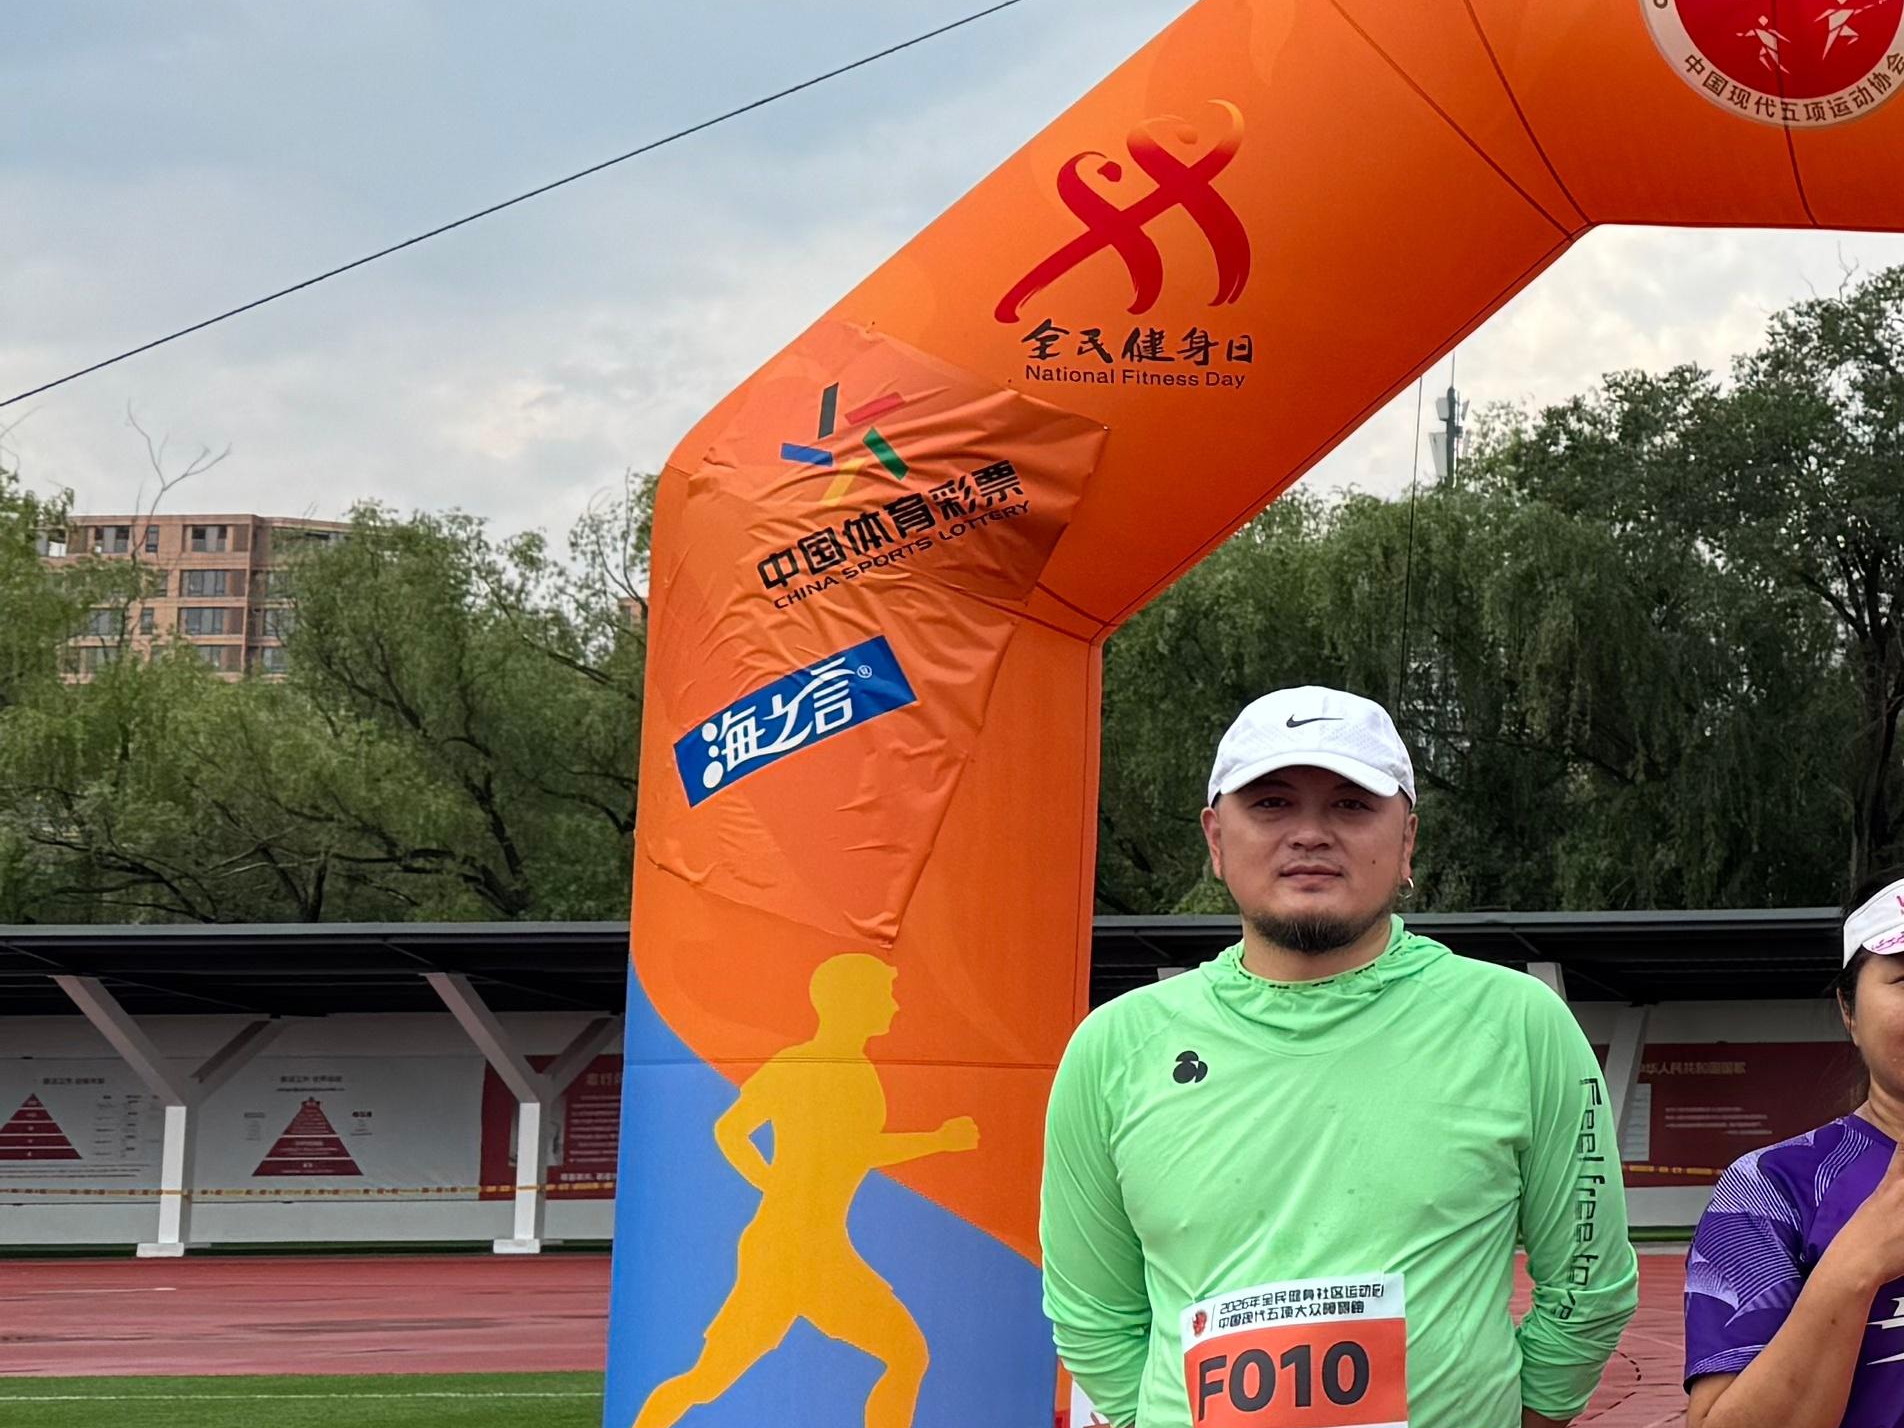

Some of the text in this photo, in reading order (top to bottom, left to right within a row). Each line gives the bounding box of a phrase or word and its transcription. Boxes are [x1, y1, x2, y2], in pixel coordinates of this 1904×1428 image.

[1020, 319, 1255, 366] 全民健身日
[1025, 364, 1246, 389] National Fitness Day
[756, 459, 1025, 590] 中国体育彩票
[774, 500, 1032, 610] CHINA SPORTS LOTTERY
[1578, 1077, 1605, 1163] Feel
[1573, 1174, 1605, 1244] free
[1198, 1341, 1370, 1422] F010
